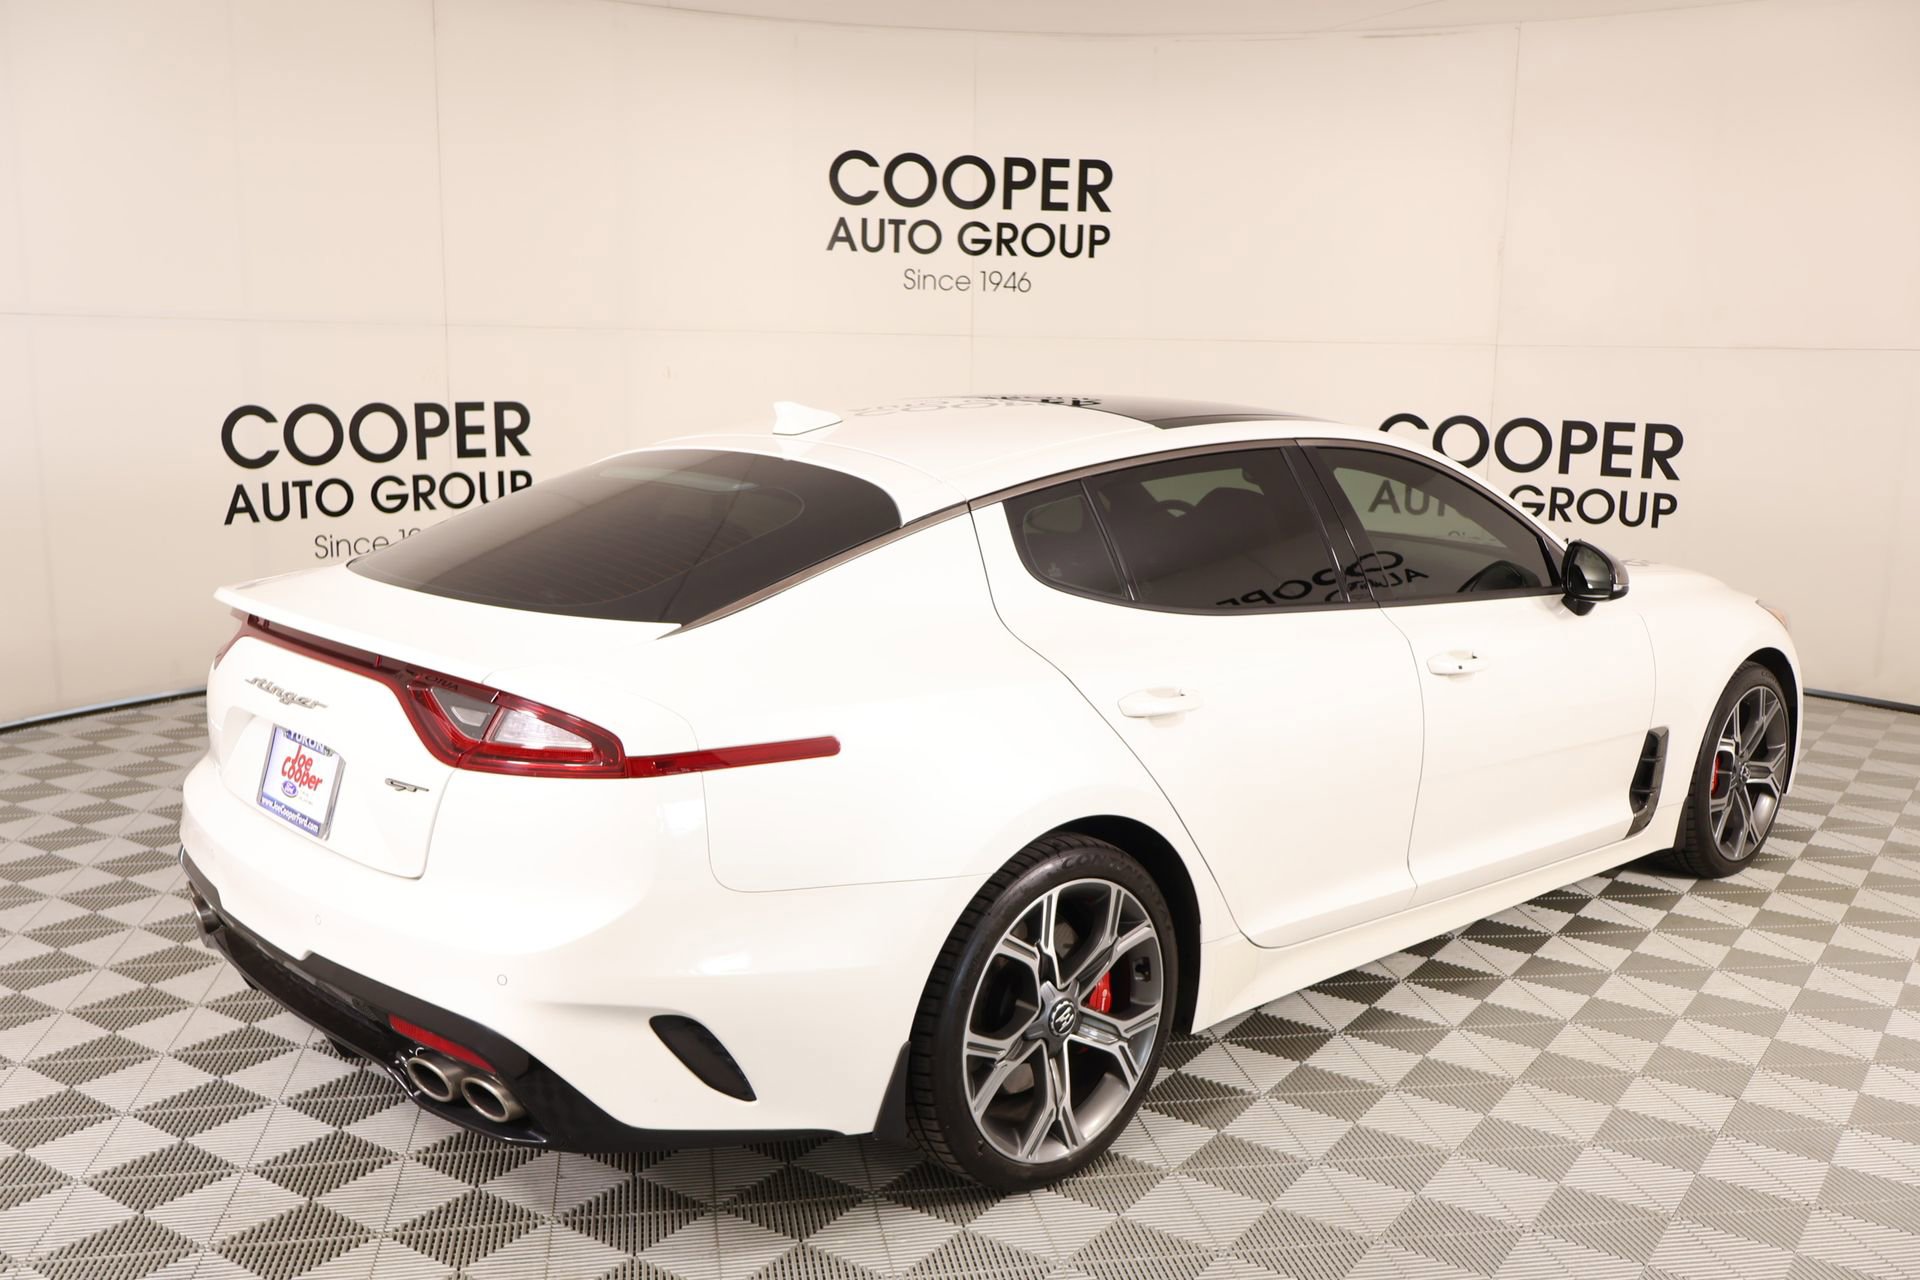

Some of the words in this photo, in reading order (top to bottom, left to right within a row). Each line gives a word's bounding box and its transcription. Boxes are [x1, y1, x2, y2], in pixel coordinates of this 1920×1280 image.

[829, 150, 1113, 212] COOPER
[826, 216, 942, 254] AUTO
[957, 221, 1111, 258] GROUP
[903, 268, 971, 292] Since
[980, 270, 1032, 293] 1946
[221, 401, 532, 470] COOPER
[224, 478, 354, 525] AUTO
[1509, 484, 1678, 528] GROUP
[281, 756, 323, 791] Cooper
[292, 744, 313, 771] Joe
